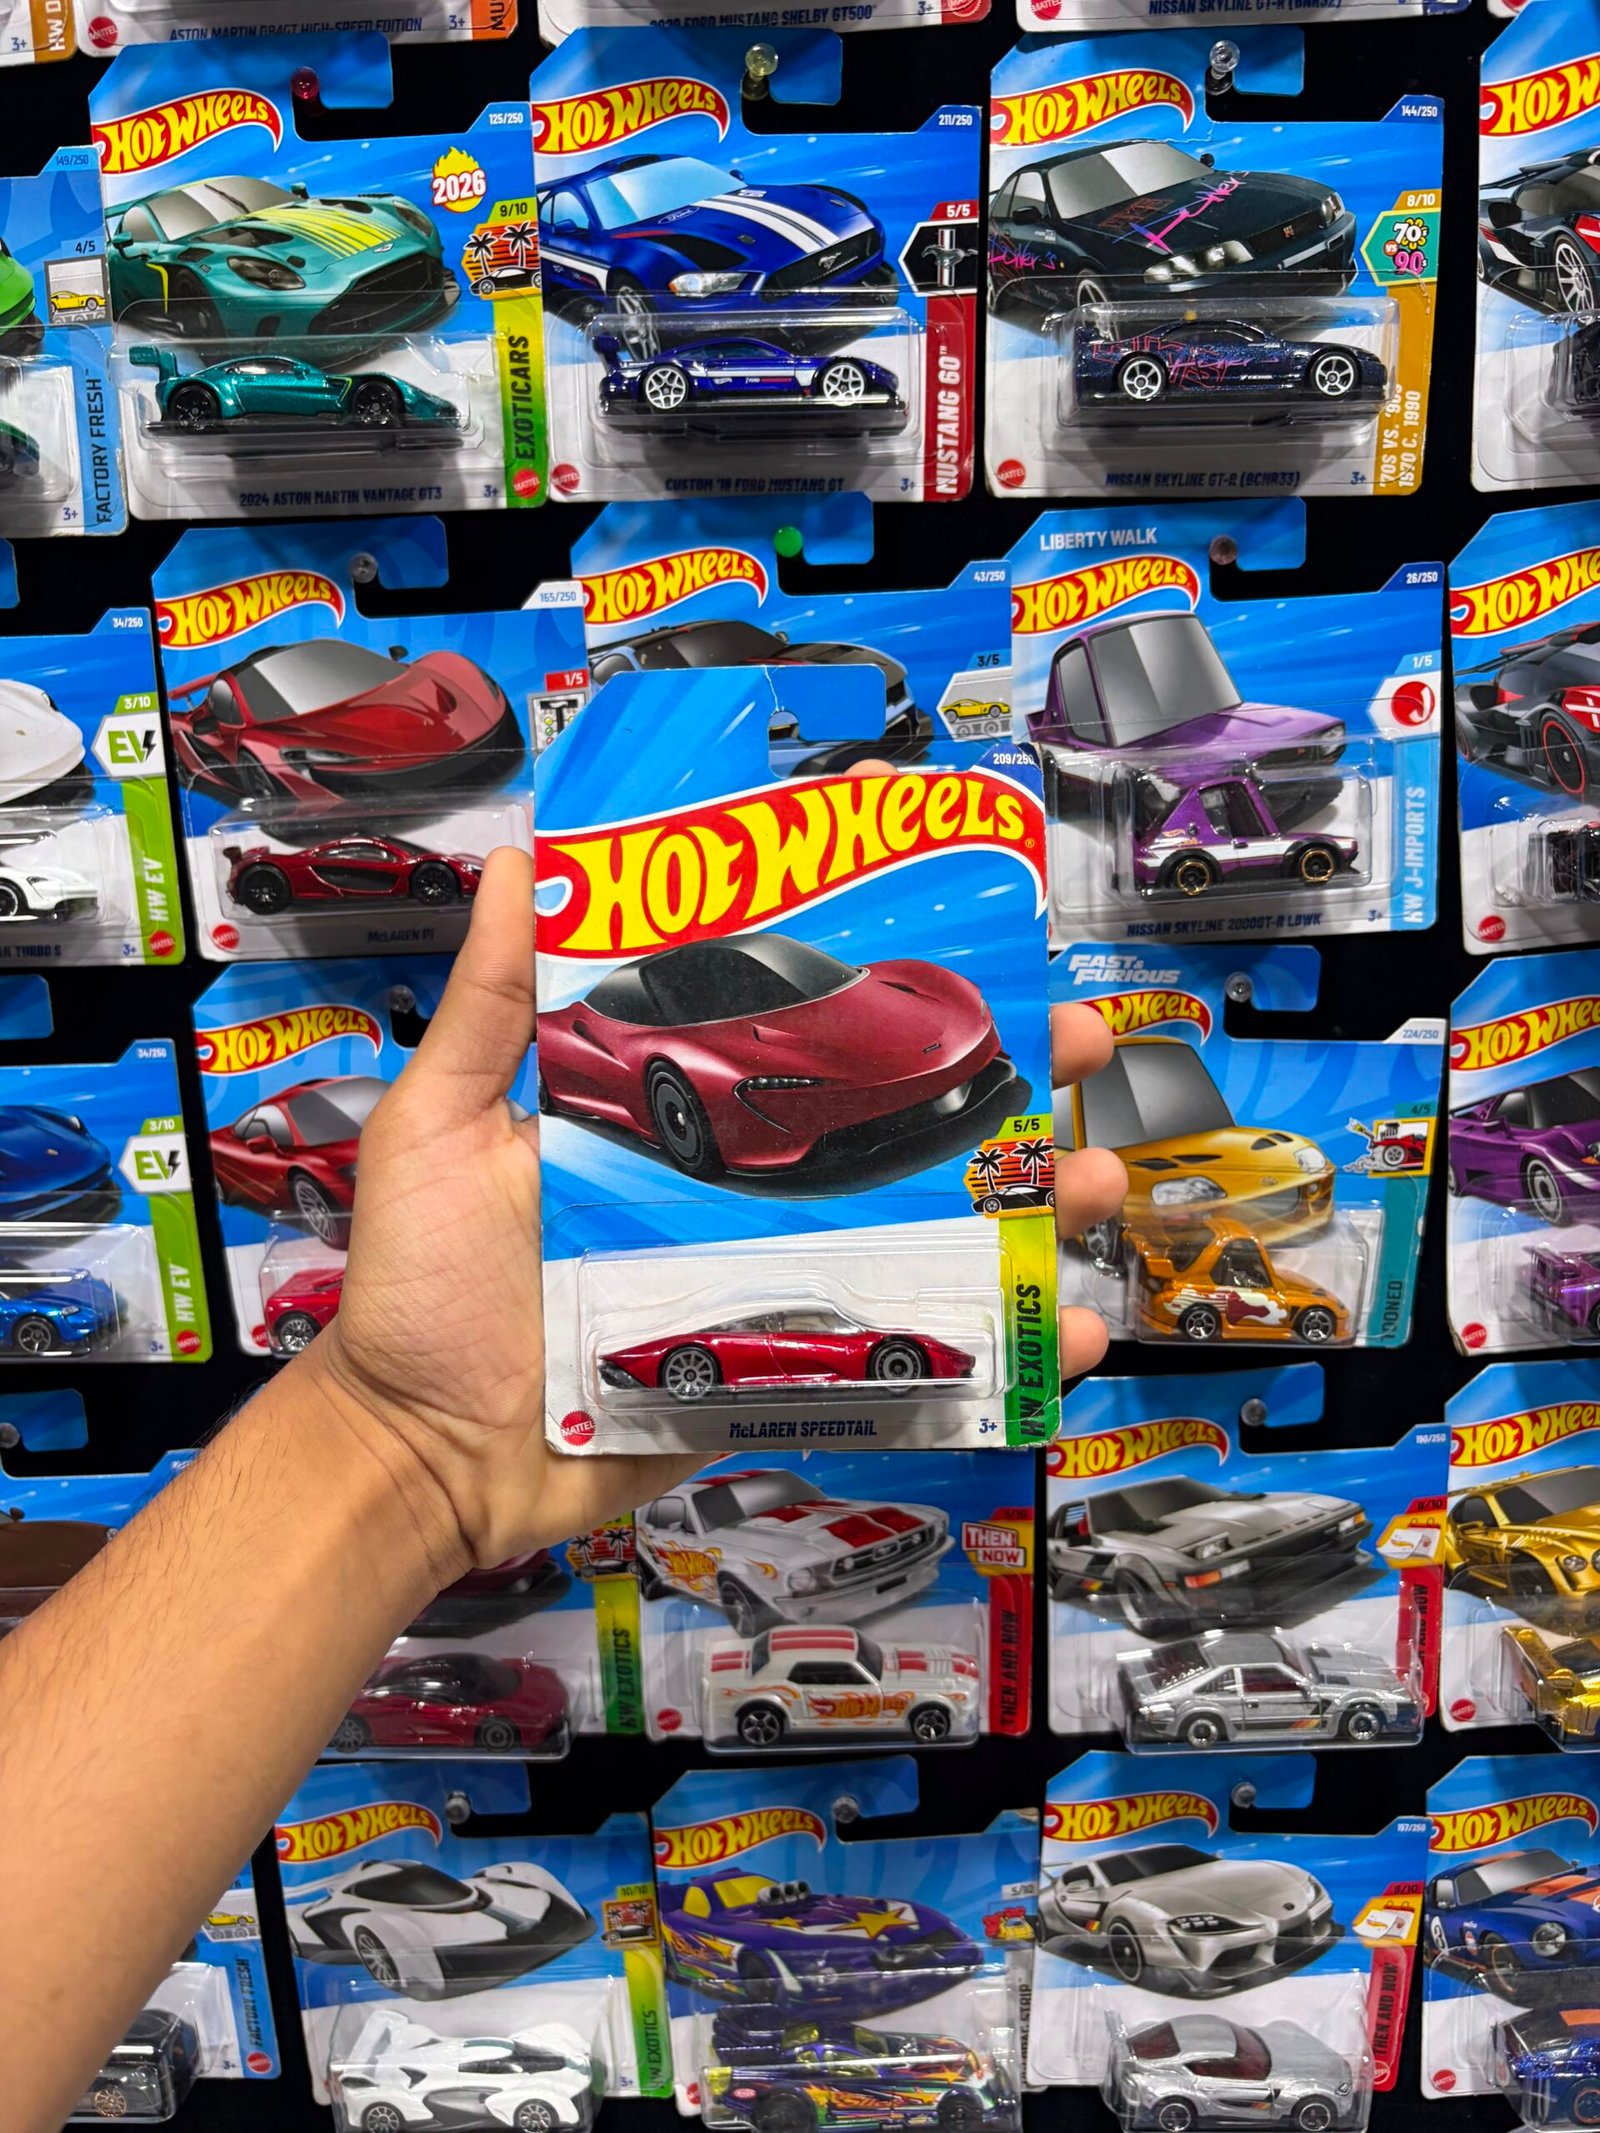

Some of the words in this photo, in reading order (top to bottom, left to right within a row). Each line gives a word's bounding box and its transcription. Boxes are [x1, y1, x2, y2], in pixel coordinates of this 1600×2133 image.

[719, 11, 779, 26] MUSTANG
[781, 8, 828, 26] SHELBY
[832, 5, 872, 20] GT500
[917, 1, 934, 16] 3+
[1149, 0, 1195, 15] NISSAN
[1199, 0, 1253, 13] SKYLINE
[170, 28, 208, 41] ASTON
[211, 25, 257, 39] MARTIN
[376, 18, 423, 32] EDITION
[449, 15, 466, 30] 3+
[47, 18, 66, 51] HW
[488, 112, 524, 125] 125/250
[1401, 105, 1438, 118] 144/250
[938, 114, 973, 126] 211/250
[55, 154, 89, 166] 149/250
[431, 169, 487, 205] 2026
[1406, 193, 1436, 207] 8/10
[499, 202, 528, 217] 9/10
[946, 203, 971, 218] 5/5
[75, 239, 96, 254] 4/5
[937, 357, 961, 386] 60
[508, 335, 536, 461] EXOTICARS
[86, 378, 106, 438] FRESH
[1403, 390, 1421, 426] 1990
[936, 390, 960, 495] MUSTANG
[94, 445, 112, 523] FACTORY
[664, 478, 714, 492] CUSTOM
[734, 478, 766, 492] FORD
[768, 478, 826, 492] MUSTANG
[1105, 472, 1151, 487] NISSAN
[1154, 472, 1206, 487] SKYLINE
[1350, 471, 1367, 485] 3+
[240, 492, 270, 507] 2024
[273, 490, 314, 506] ASTON
[314, 488, 361, 505] MARTIN
[363, 487, 416, 503] VANTAGE
[418, 486, 442, 500] GT3
[483, 484, 499, 498] 3+
[63, 507, 79, 521] 3+
[1040, 531, 1108, 551] LIBERTY
[1110, 528, 1158, 546] WALK
[973, 570, 1006, 583] 43/250
[1405, 571, 1438, 585] 26/250
[539, 591, 577, 603] 165/250
[112, 617, 143, 629] 34/250
[976, 653, 1000, 668] 3/5
[1412, 654, 1433, 669] 1/5
[564, 672, 584, 687] 1/5
[123, 696, 151, 710] 3/10
[1404, 786, 1426, 888] J-IMPORTS
[143, 857, 165, 884] EV
[147, 889, 170, 923] HW
[1127, 922, 1172, 937] NISSAN
[1174, 918, 1225, 934] SKYLINE
[122, 944, 137, 956] 3+
[1067, 954, 1138, 971] FAST
[1072, 969, 1181, 985] FURIOUS
[1402, 1029, 1439, 1040] 224/250
[1410, 1105, 1430, 1115] 4/5
[1013, 1118, 1041, 1132] 5/5
[168, 1264, 191, 1289] EV
[173, 1293, 196, 1322] HW
[1017, 1283, 1043, 1388] EXOTICS
[978, 1417, 998, 1434] 3+
[1019, 1399, 1046, 1438] HW
[559, 1420, 595, 1437] MATTEL
[729, 1420, 797, 1439] McLAREN
[799, 1419, 878, 1437] SPEEDTAIL
[967, 1526, 1013, 1548] THEN
[981, 1549, 1020, 1564] NOW
[612, 1627, 636, 1697] EXOTICS
[1001, 1684, 1018, 1726] THEN
[1011, 1884, 1034, 1896] 5/10
[1382, 1962, 1399, 1985] NOW
[1378, 1995, 1395, 2019] AND
[646, 2010, 663, 2063] EXOTICS
[1374, 2020, 1391, 2056] THEN
